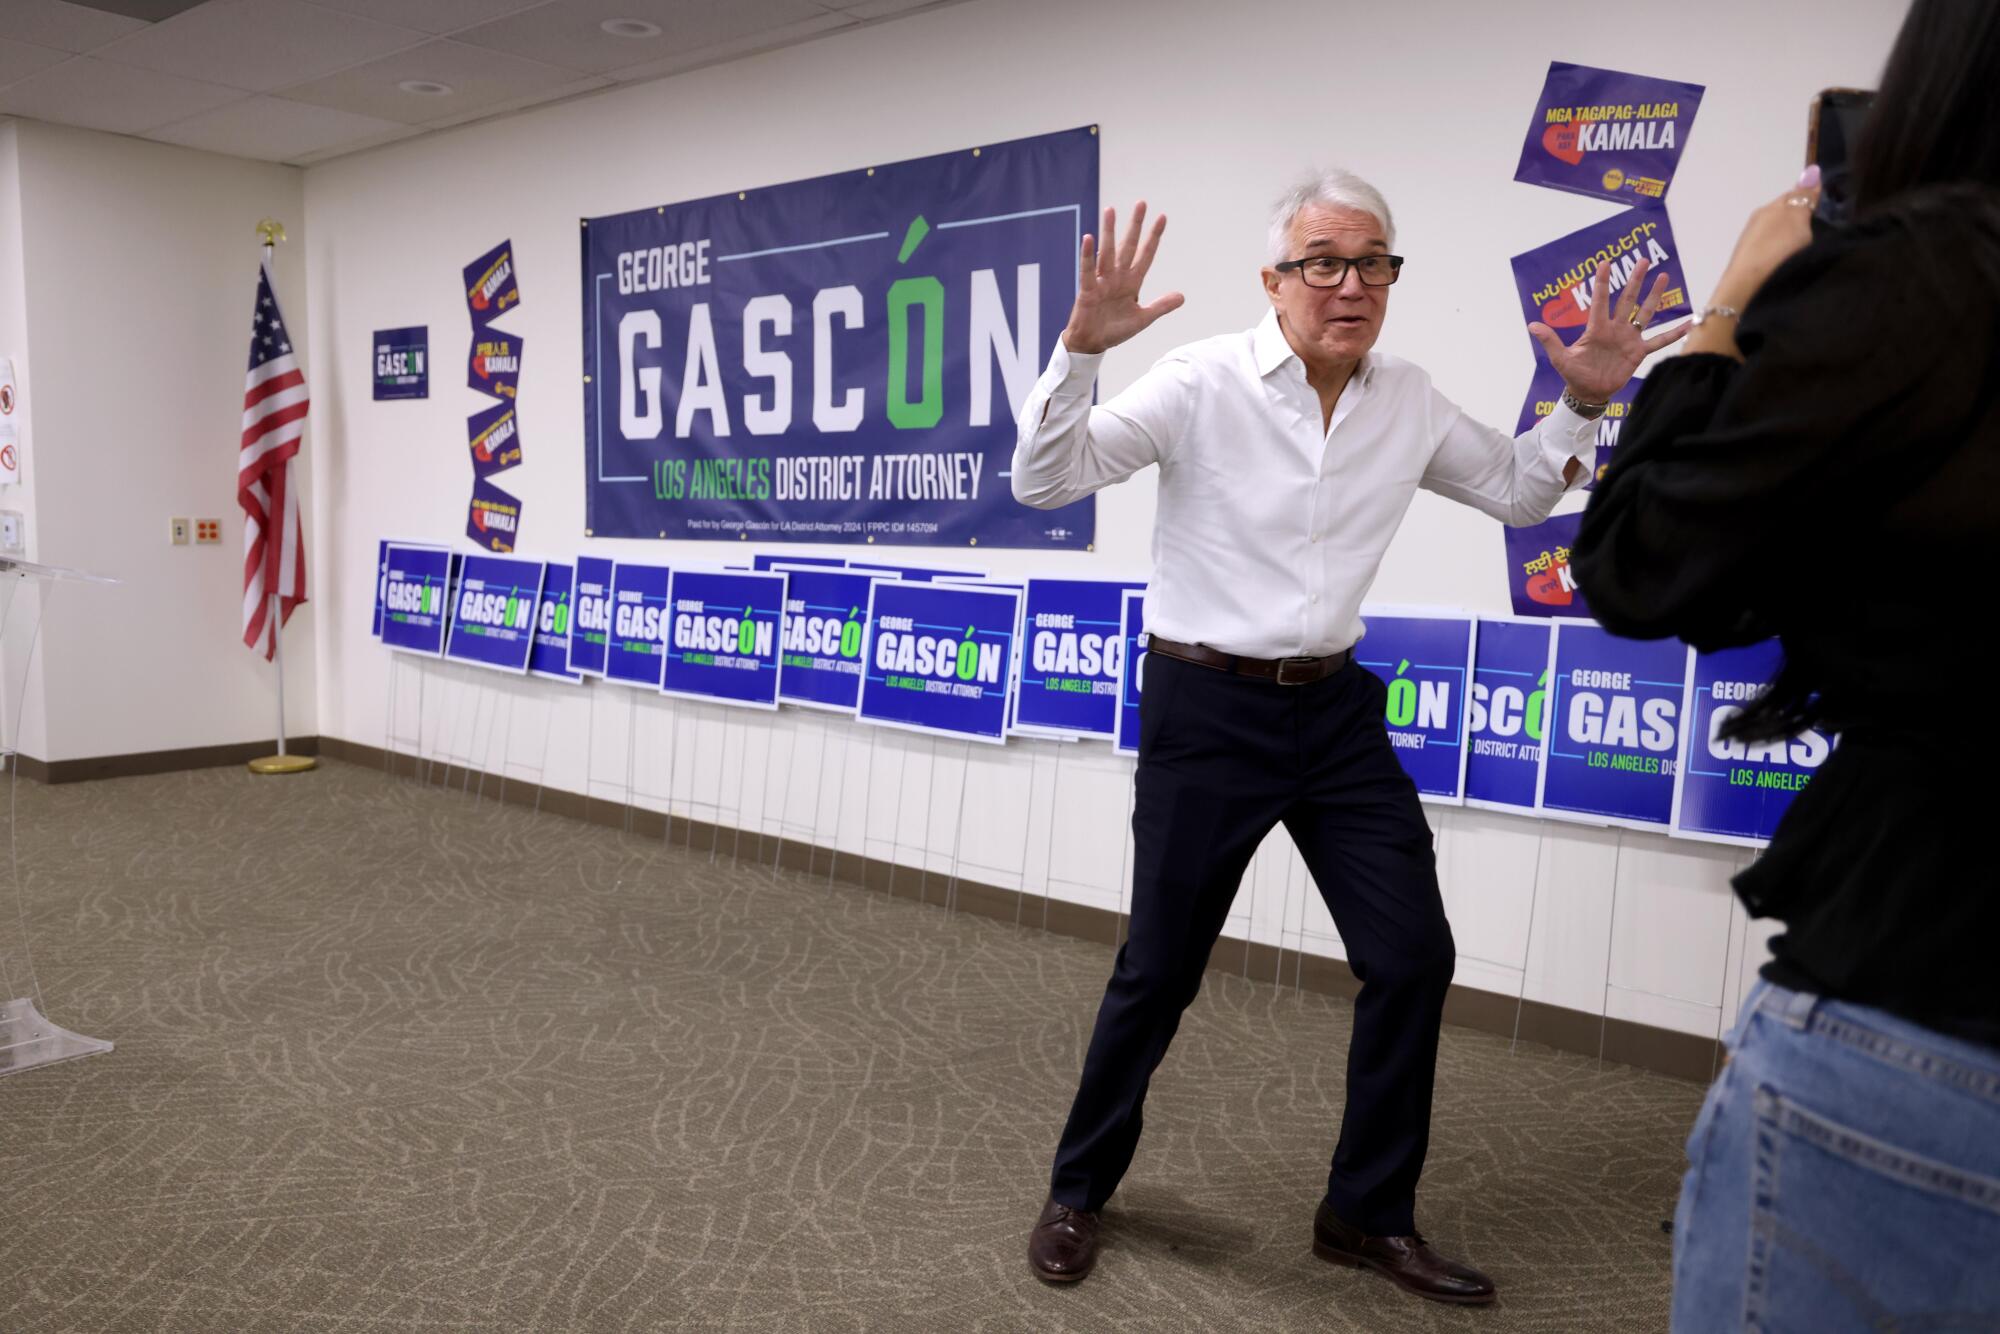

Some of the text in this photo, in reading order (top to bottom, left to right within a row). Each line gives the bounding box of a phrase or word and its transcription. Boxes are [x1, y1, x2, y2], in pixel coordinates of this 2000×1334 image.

[1546, 102, 1678, 122] MGA TAGAPAG-ALAGA
[1577, 121, 1675, 151] KAMALA
[618, 239, 711, 295] GEORGE
[618, 215, 1040, 440] GASCÓN
[654, 453, 983, 500] LOS ANGELES DISTRICT ATTORNEY
[387, 574, 442, 616] GASCÓN
[460, 585, 532, 630] GASCÓN
[674, 605, 774, 657] GASCÓN
[879, 615, 914, 632] GEORGE
[1035, 613, 1075, 630] GEORGE
[876, 624, 1002, 684] GASCÓN
[1045, 677, 1059, 691] LOS
[1060, 679, 1092, 694] ANGELES
[1571, 669, 1632, 691] GEORGE
[1568, 691, 1677, 752] GAS
[1474, 738, 1518, 760] DISTRICT
[1587, 751, 1609, 768] LOS
[1610, 754, 1659, 774] ANGELES
[1730, 768, 1754, 786] LOS
